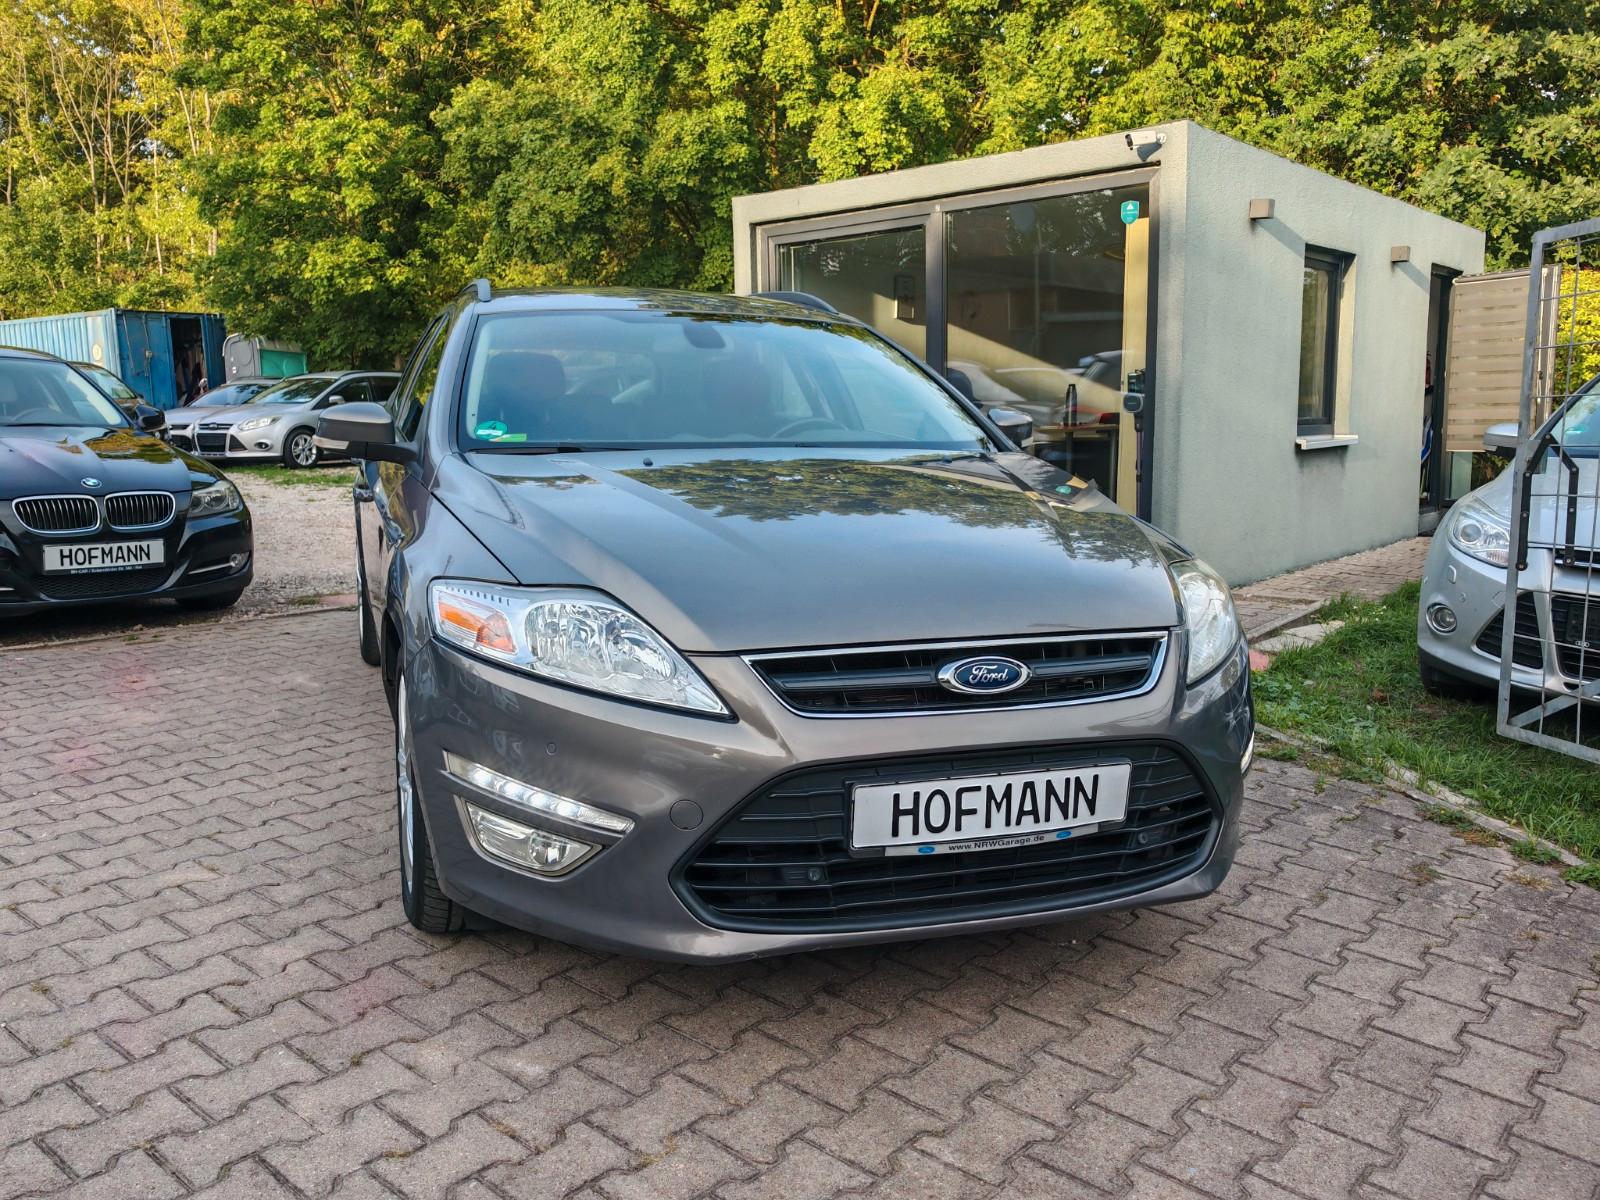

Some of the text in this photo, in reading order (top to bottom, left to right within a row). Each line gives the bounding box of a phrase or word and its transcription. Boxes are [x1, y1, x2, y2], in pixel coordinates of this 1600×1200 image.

[60, 544, 151, 566] HOFMANN
[969, 665, 1009, 684] Ford
[891, 774, 1099, 838] HOFMANN
[948, 835, 1045, 851] www.NRWGarage.de
